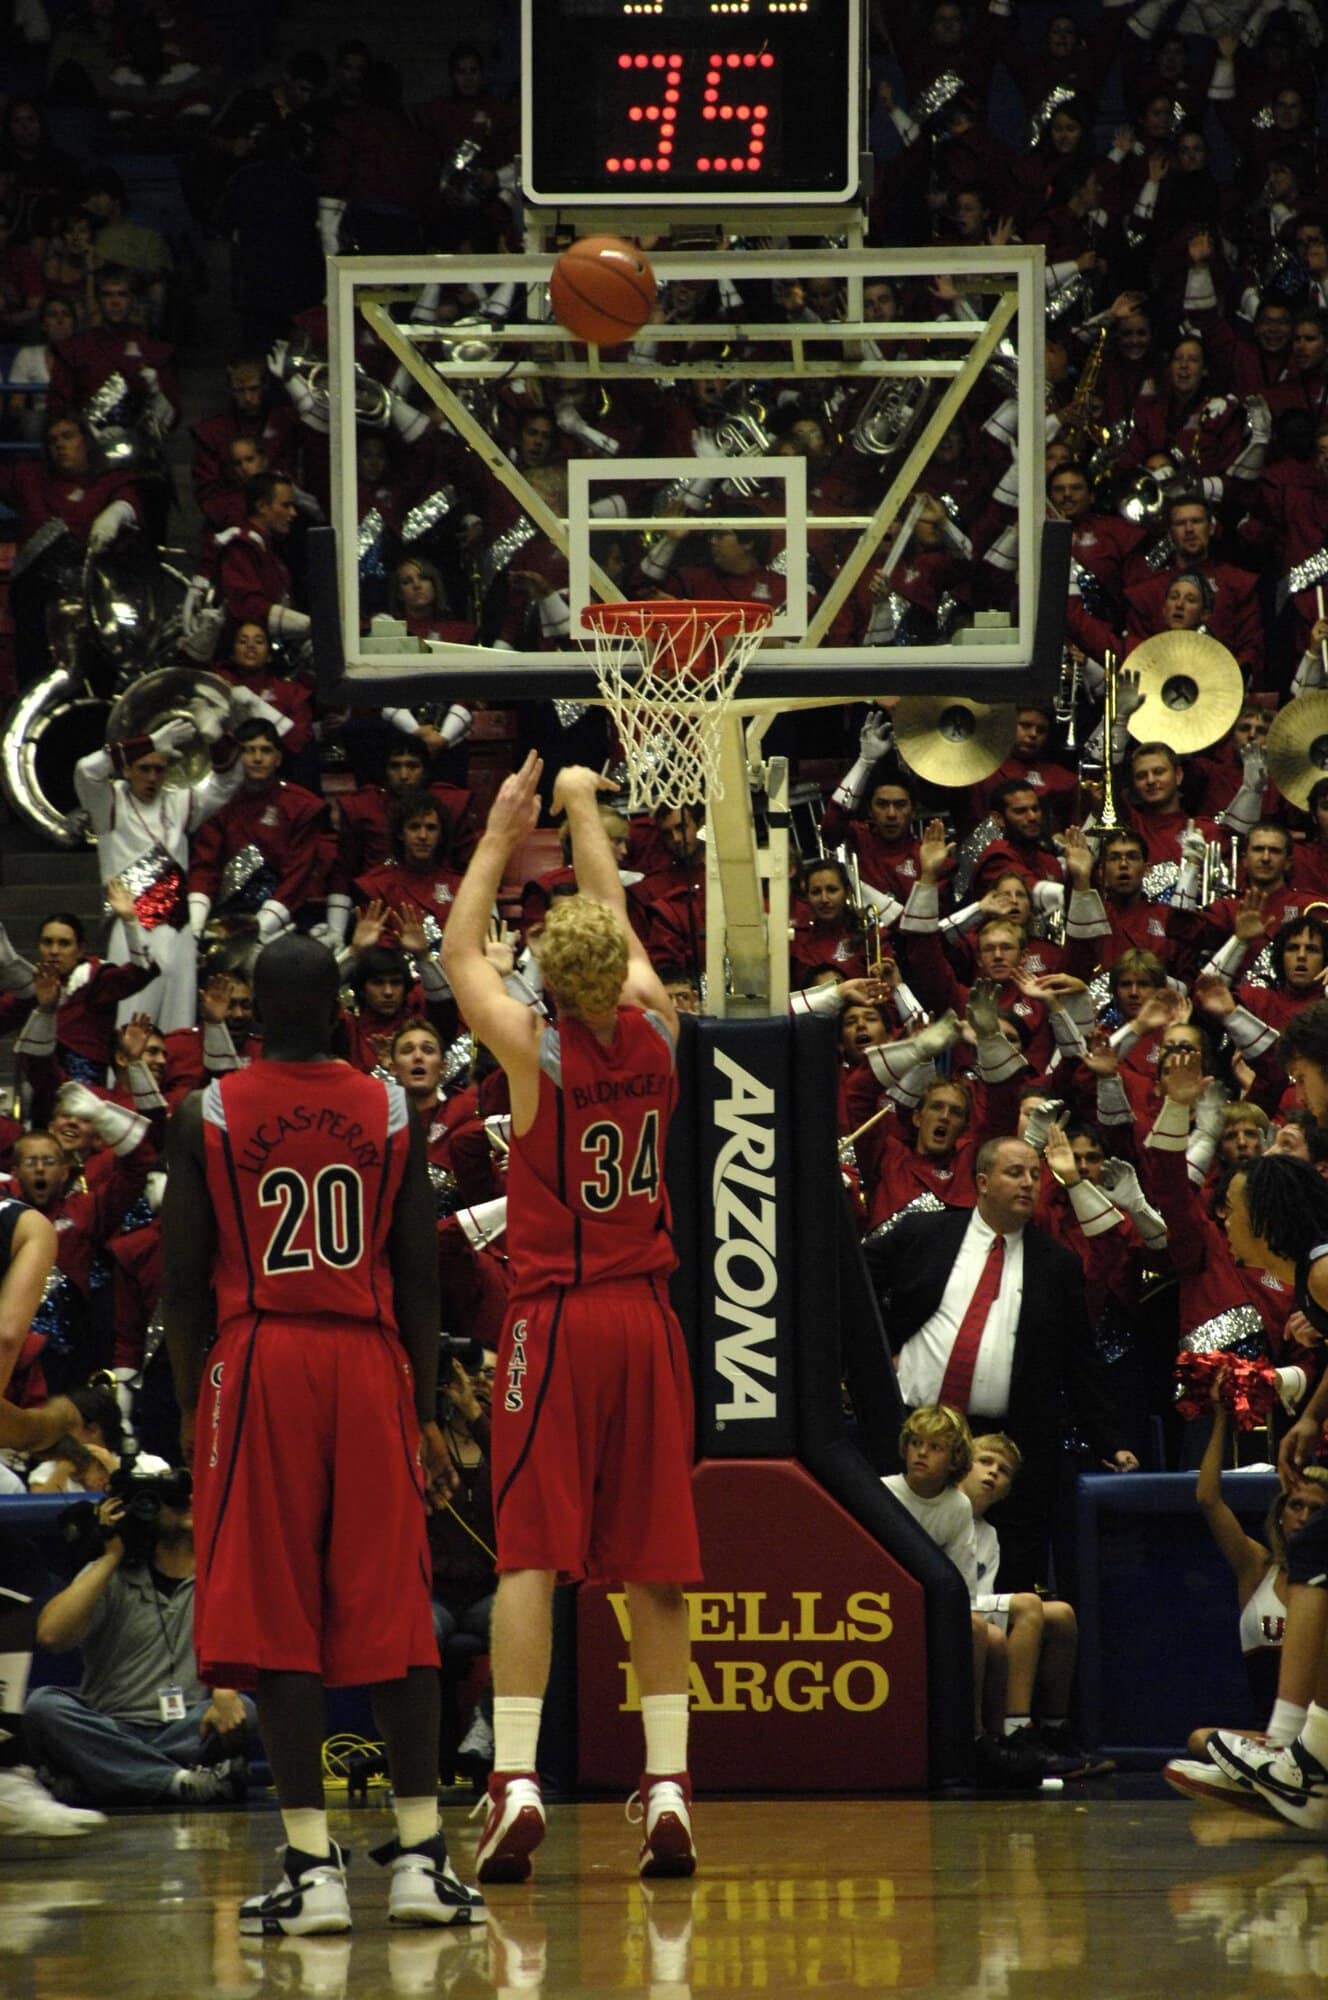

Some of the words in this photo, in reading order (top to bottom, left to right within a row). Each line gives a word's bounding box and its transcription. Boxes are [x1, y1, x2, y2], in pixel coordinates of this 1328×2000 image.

[606, 54, 775, 172] 35
[580, 1109, 660, 1213] 34
[258, 1163, 364, 1276] 20
[712, 1046, 779, 1422] ARIZONA
[504, 1319, 528, 1412] CATS
